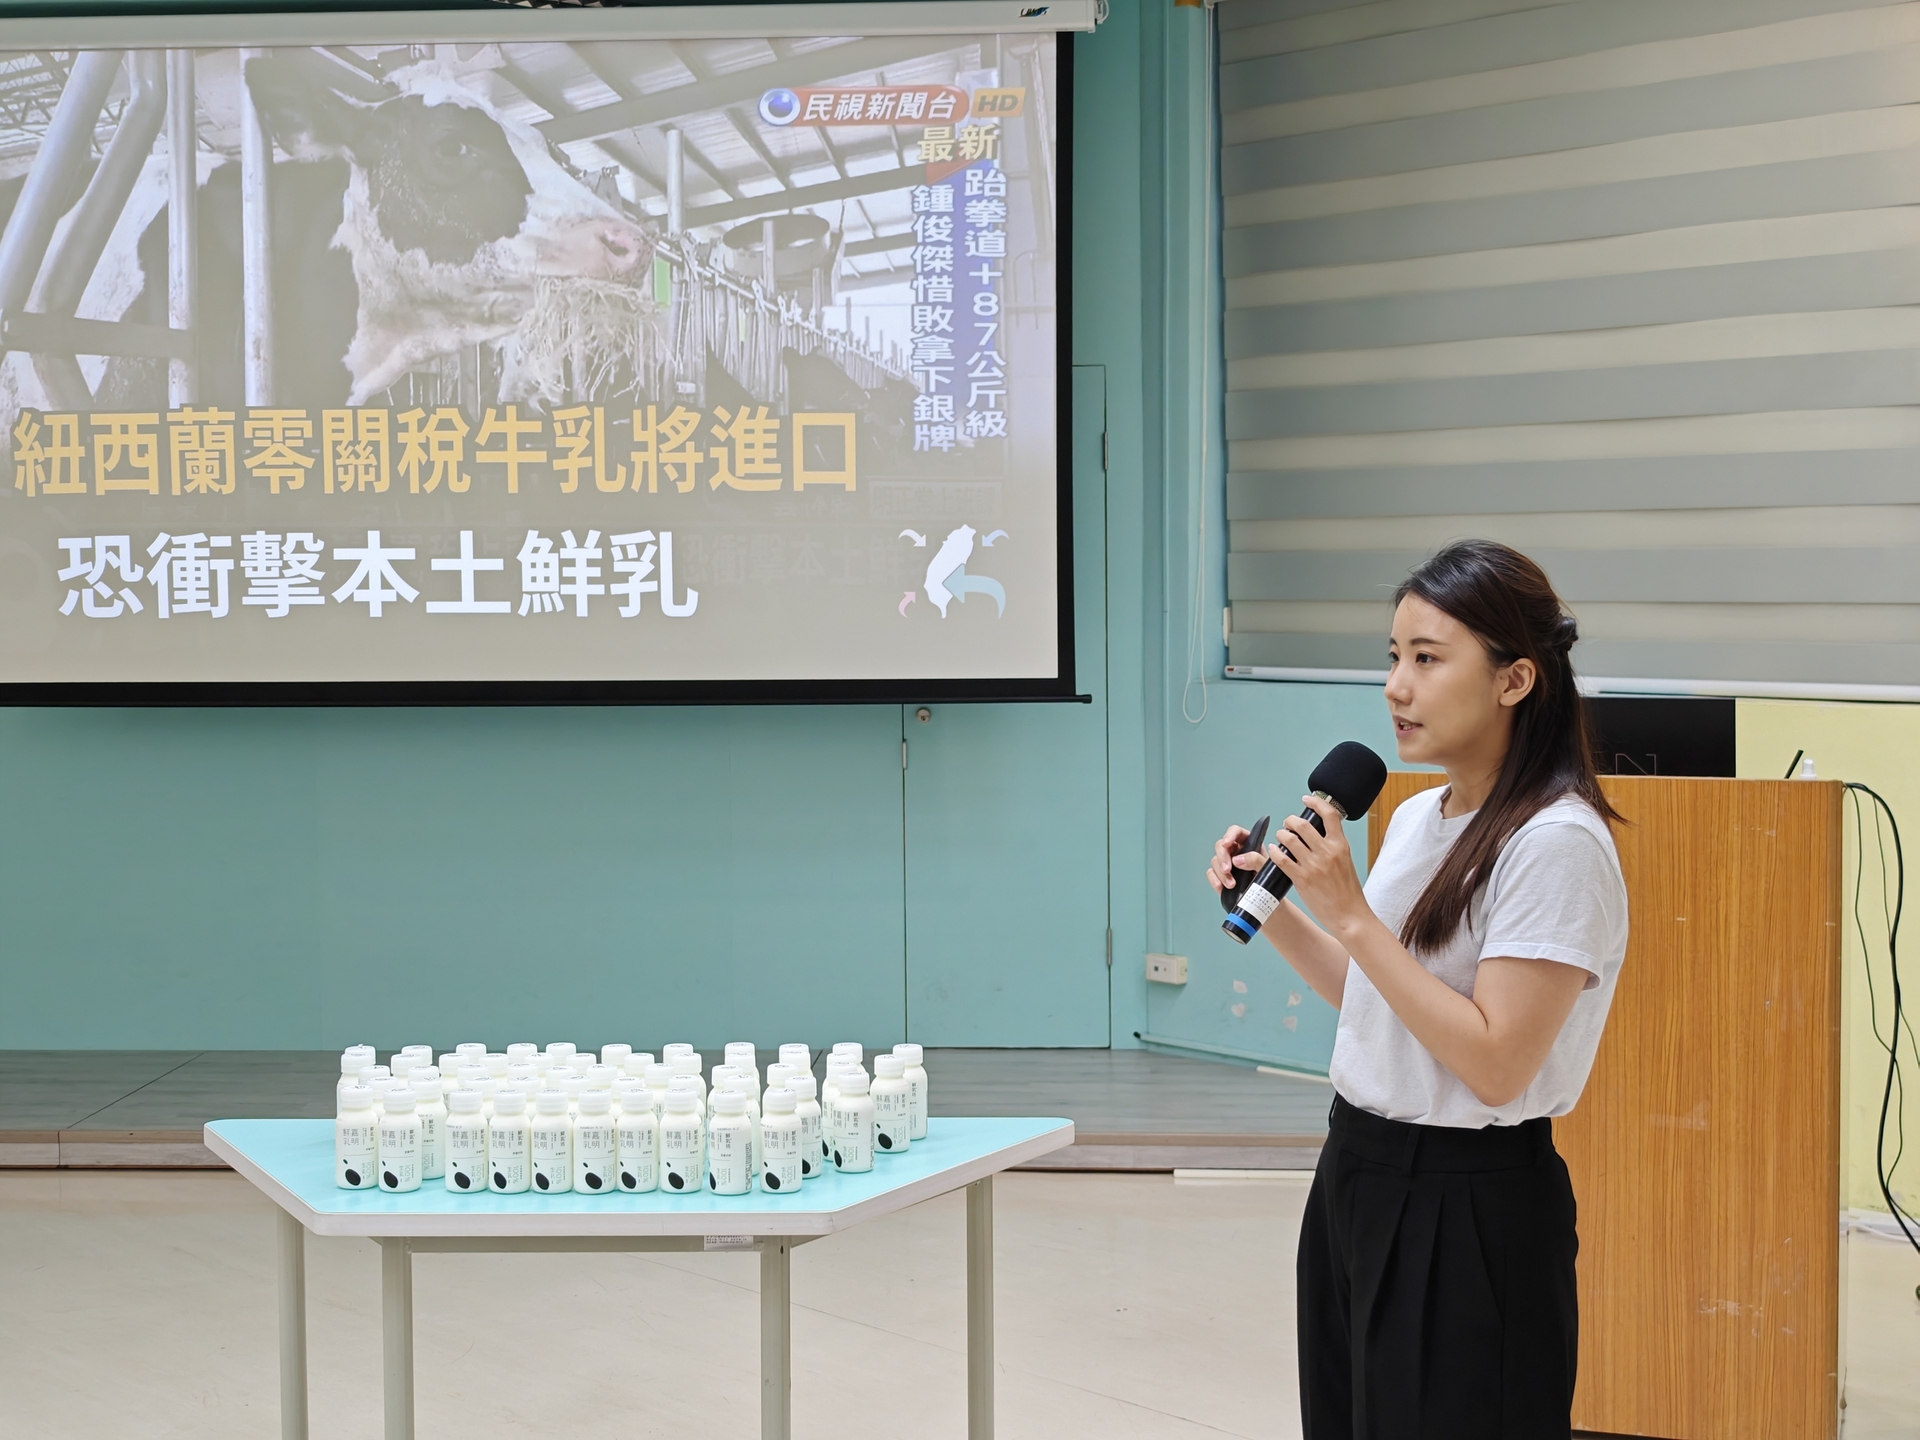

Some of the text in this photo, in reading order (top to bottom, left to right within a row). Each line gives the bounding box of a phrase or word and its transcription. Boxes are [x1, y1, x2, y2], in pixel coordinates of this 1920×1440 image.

[803, 91, 957, 121] 民視新聞台
[977, 94, 1019, 113] HD
[917, 123, 1000, 163] 最新
[910, 184, 956, 453] 鍾俊傑惜敗拿下銀牌
[12, 404, 858, 498] 紐西蘭零關稅牛乳將進口
[57, 529, 699, 620] 恐衝擊本土鮮乳
